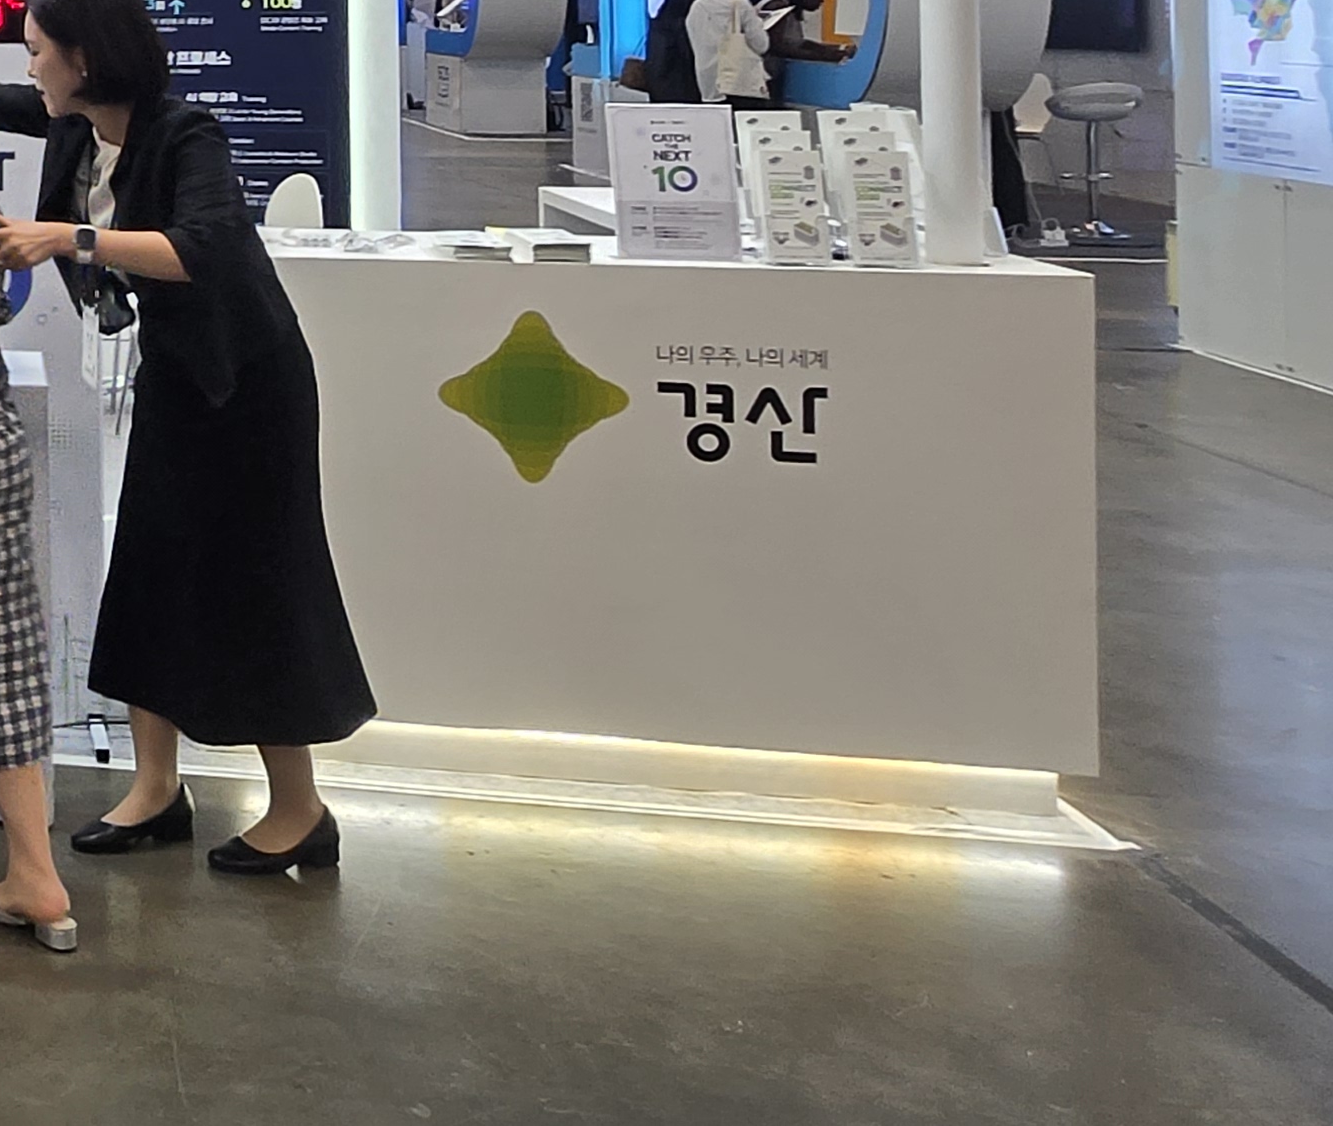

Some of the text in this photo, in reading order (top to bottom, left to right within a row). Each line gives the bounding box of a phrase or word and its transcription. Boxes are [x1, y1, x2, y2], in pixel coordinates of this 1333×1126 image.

[651, 133, 692, 143] CATCH
[652, 150, 692, 162] NEXT
[651, 165, 698, 193] 10
[656, 345, 829, 370] 나의 우주, 나의 세계
[657, 381, 829, 464] 경산
